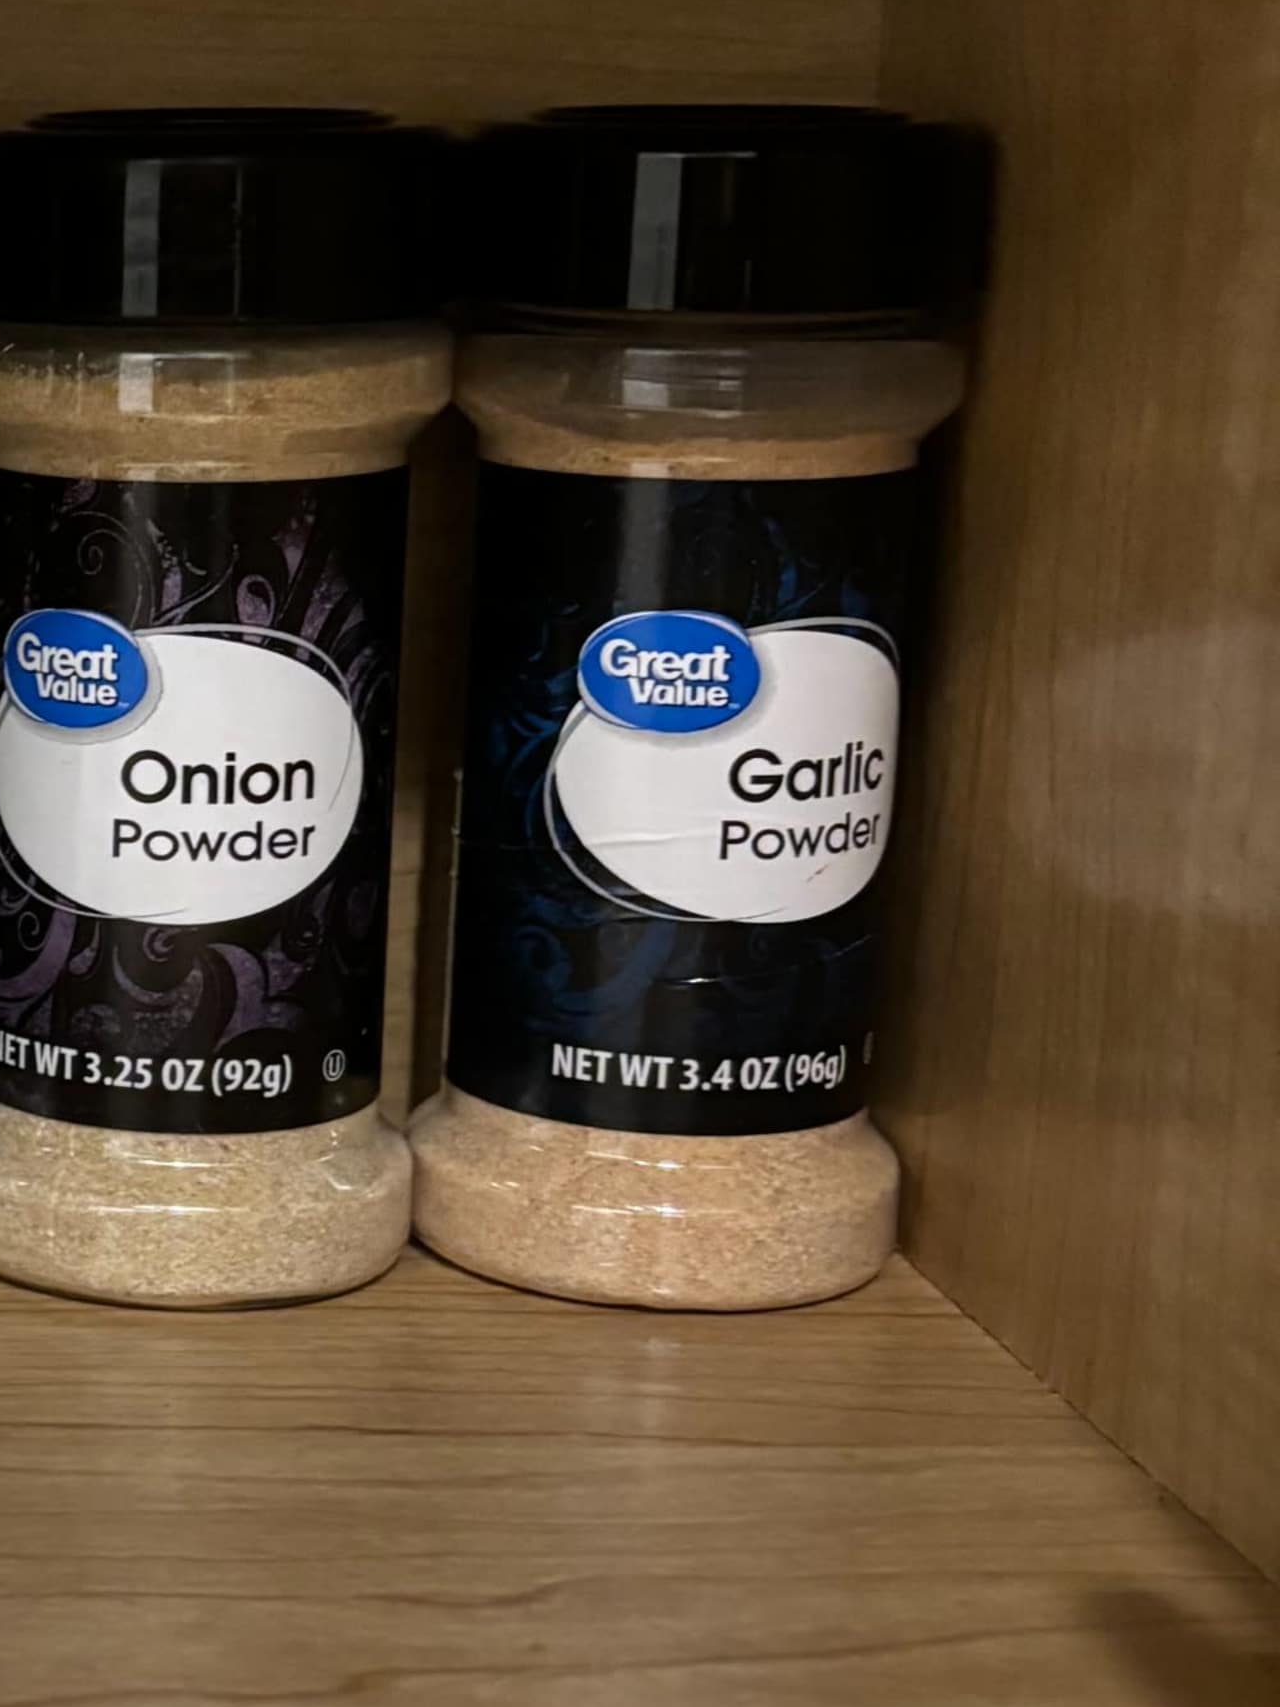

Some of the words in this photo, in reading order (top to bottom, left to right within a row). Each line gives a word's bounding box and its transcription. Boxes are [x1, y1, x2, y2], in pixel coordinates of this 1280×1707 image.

[17, 632, 118, 682] Great
[601, 639, 730, 682] Great
[37, 674, 117, 706] Value
[627, 678, 728, 708] Value
[121, 749, 315, 805] Onion
[729, 741, 884, 803] Garlic
[112, 817, 316, 862] Powder
[719, 812, 880, 860] Powder
[34, 1040, 77, 1080] WT
[83, 1051, 152, 1089] 3.25
[160, 1058, 204, 1092] OZ
[211, 1053, 292, 1098] (92g)
[551, 1043, 613, 1084] NET
[619, 1052, 674, 1090] WT
[680, 1057, 734, 1091] 3.4
[740, 1057, 781, 1090] OZ
[784, 1044, 845, 1093] (96g)
